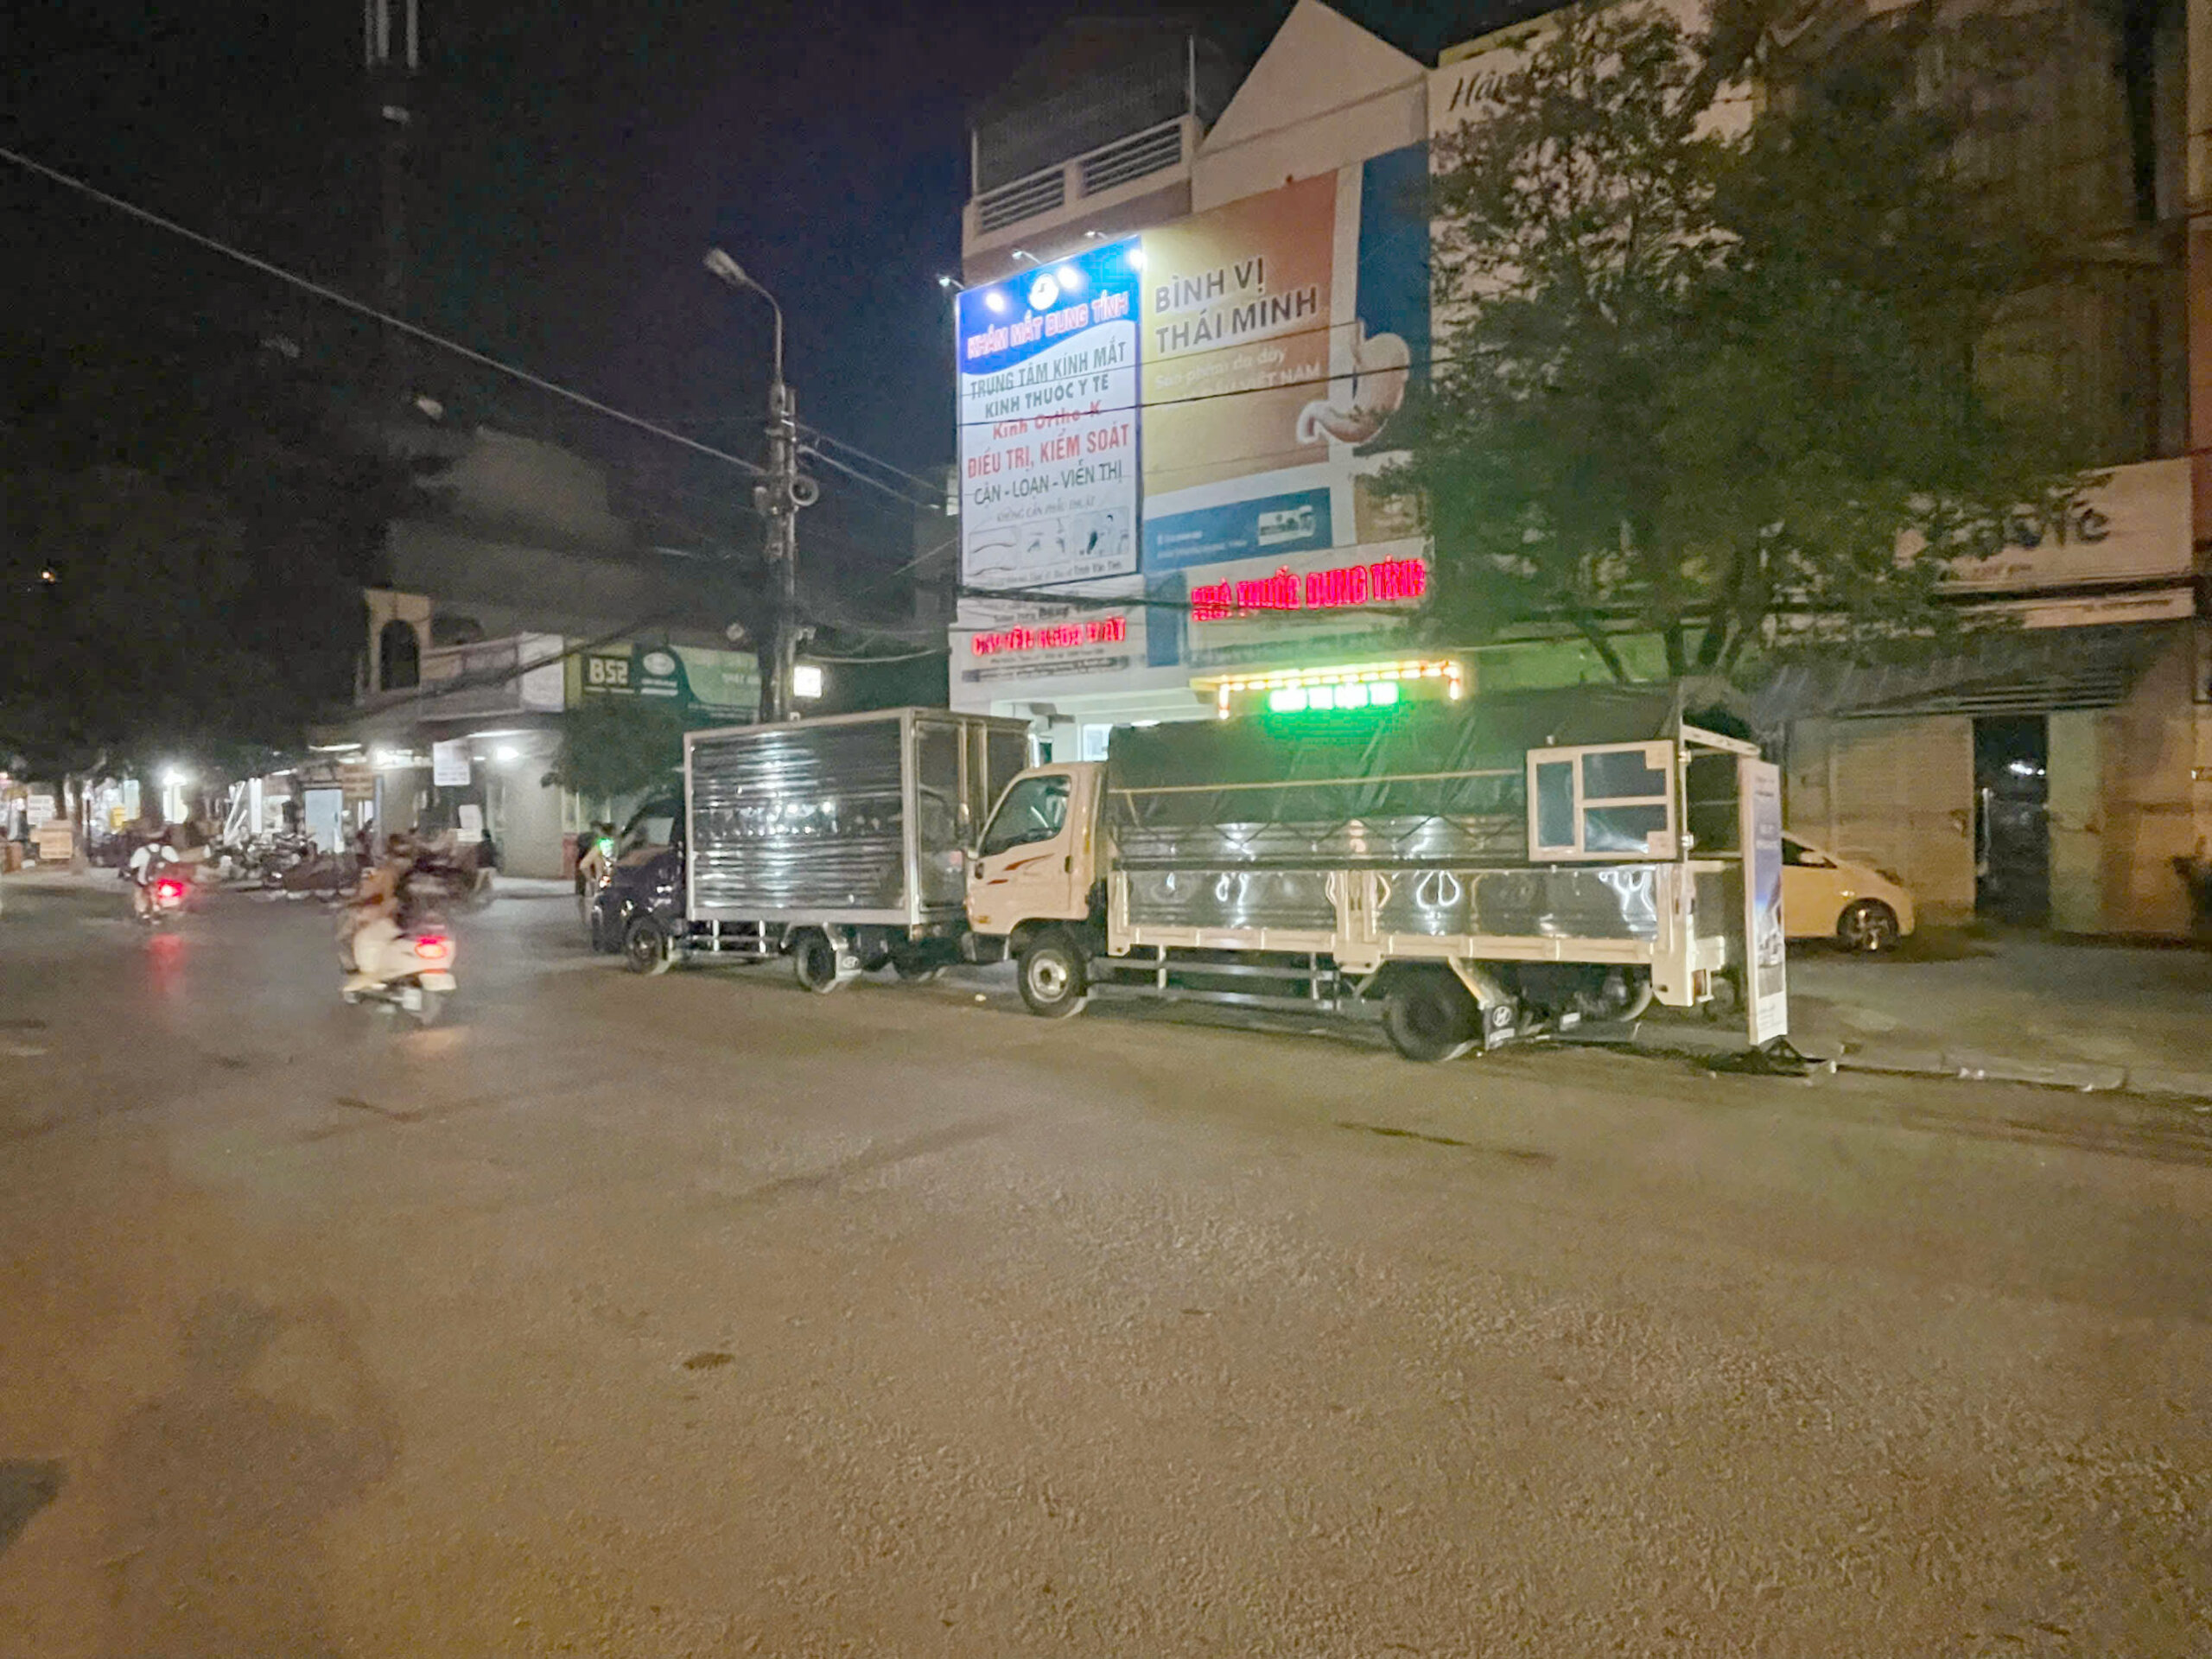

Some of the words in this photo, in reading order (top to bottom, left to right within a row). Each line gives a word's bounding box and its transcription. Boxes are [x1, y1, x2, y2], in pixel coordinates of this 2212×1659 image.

[1155, 269, 1224, 314] BÌNH
[1235, 257, 1263, 293] VỊ
[1155, 308, 1222, 353] THÁI
[1232, 287, 1317, 334] MINH
[970, 372, 1014, 399] TRUNG
[1019, 359, 1048, 386] TÂM
[1053, 352, 1088, 378] KÍNH
[1093, 336, 1126, 368] MẮT
[1080, 378, 1089, 397] Y
[1087, 421, 1129, 454] SOÁT
[1098, 460, 1122, 485] THỊ
